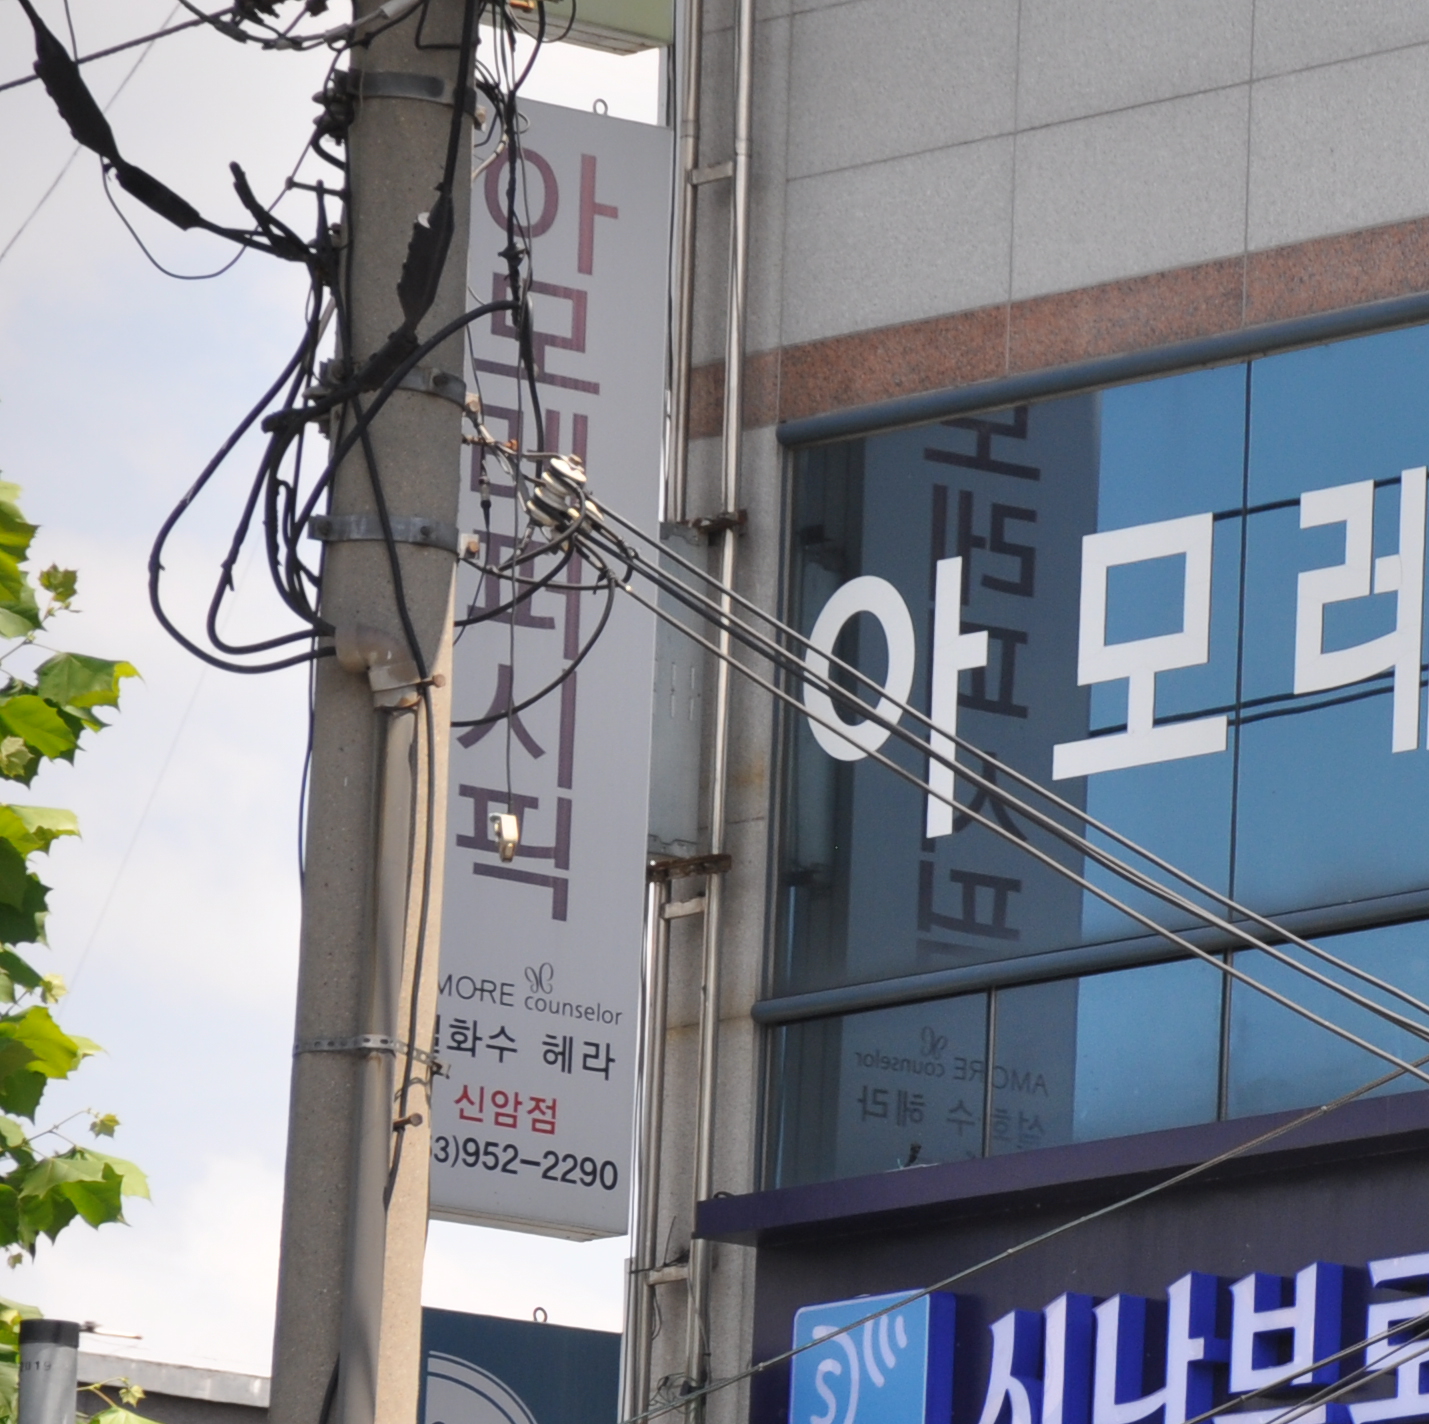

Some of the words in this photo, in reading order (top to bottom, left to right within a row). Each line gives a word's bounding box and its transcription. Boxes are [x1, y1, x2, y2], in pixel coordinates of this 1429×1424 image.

[455, 146, 619, 922] 아모레퍼시픽
[438, 974, 515, 1007] MORE
[524, 995, 623, 1025] counselor
[541, 1033, 616, 1081] 헤라
[454, 1084, 558, 1135] 신암점
[431, 1134, 618, 1191] 3)952-2290
